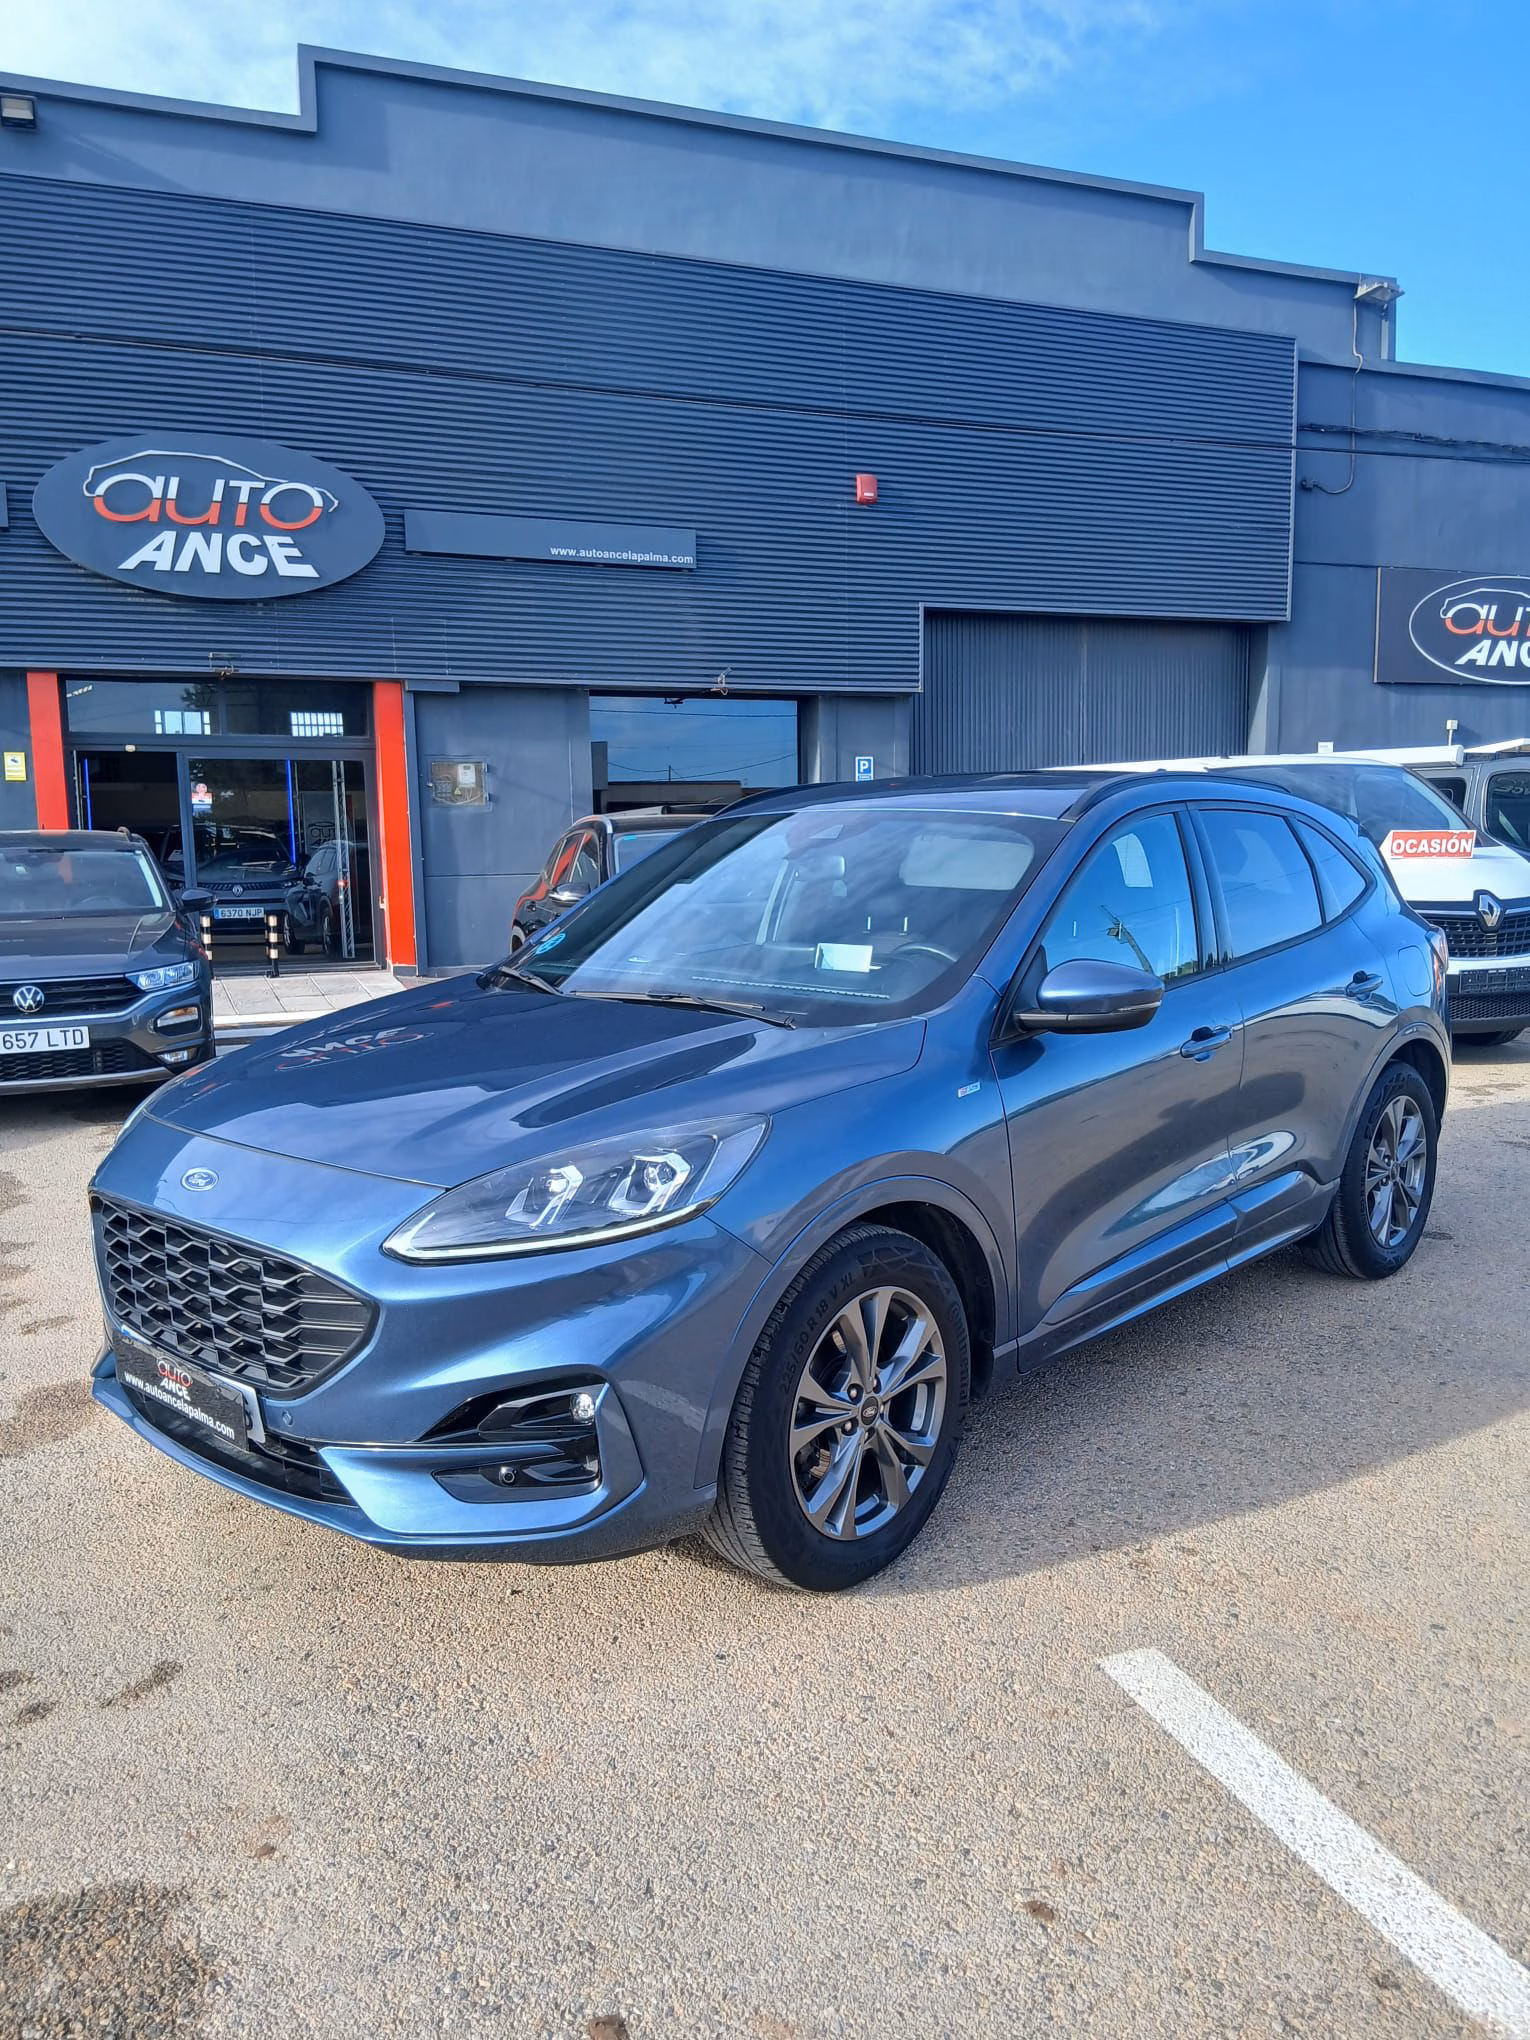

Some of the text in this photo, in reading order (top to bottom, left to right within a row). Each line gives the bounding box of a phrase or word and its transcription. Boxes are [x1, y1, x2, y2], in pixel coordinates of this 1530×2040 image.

[117, 530, 320, 578] ANCE
[550, 547, 694, 564] www.autoancelapalma.com
[1392, 835, 1473, 854] OCASIÓN
[220, 908, 263, 918] 6370 NJP
[2, 1029, 84, 1050] 657 LTD
[160, 1377, 192, 1402] ANCE
[124, 1371, 235, 1441] www.autoancelapalma.com
